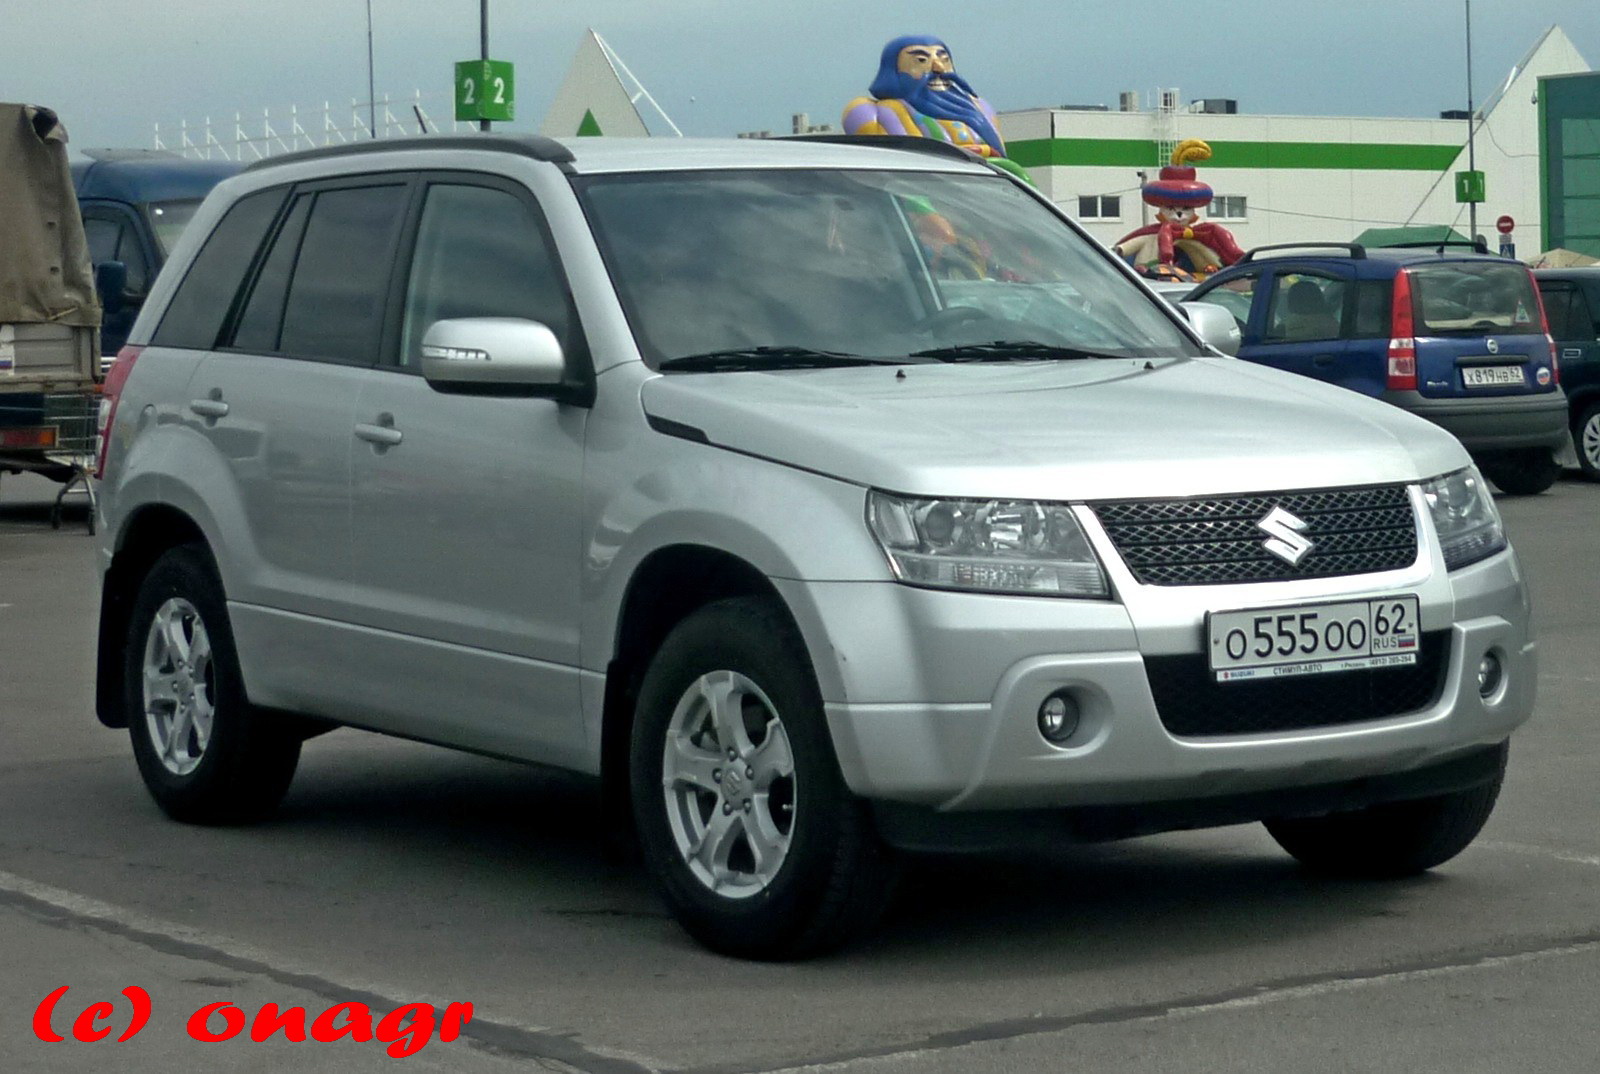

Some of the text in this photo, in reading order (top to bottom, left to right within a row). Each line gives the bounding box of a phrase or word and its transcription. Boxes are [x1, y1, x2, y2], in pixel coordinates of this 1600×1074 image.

[464, 77, 475, 104] 2
[493, 76, 505, 104] 2
[1463, 179, 1469, 194] 1
[1375, 604, 1406, 635] 62
[1373, 636, 1397, 650] RUS
